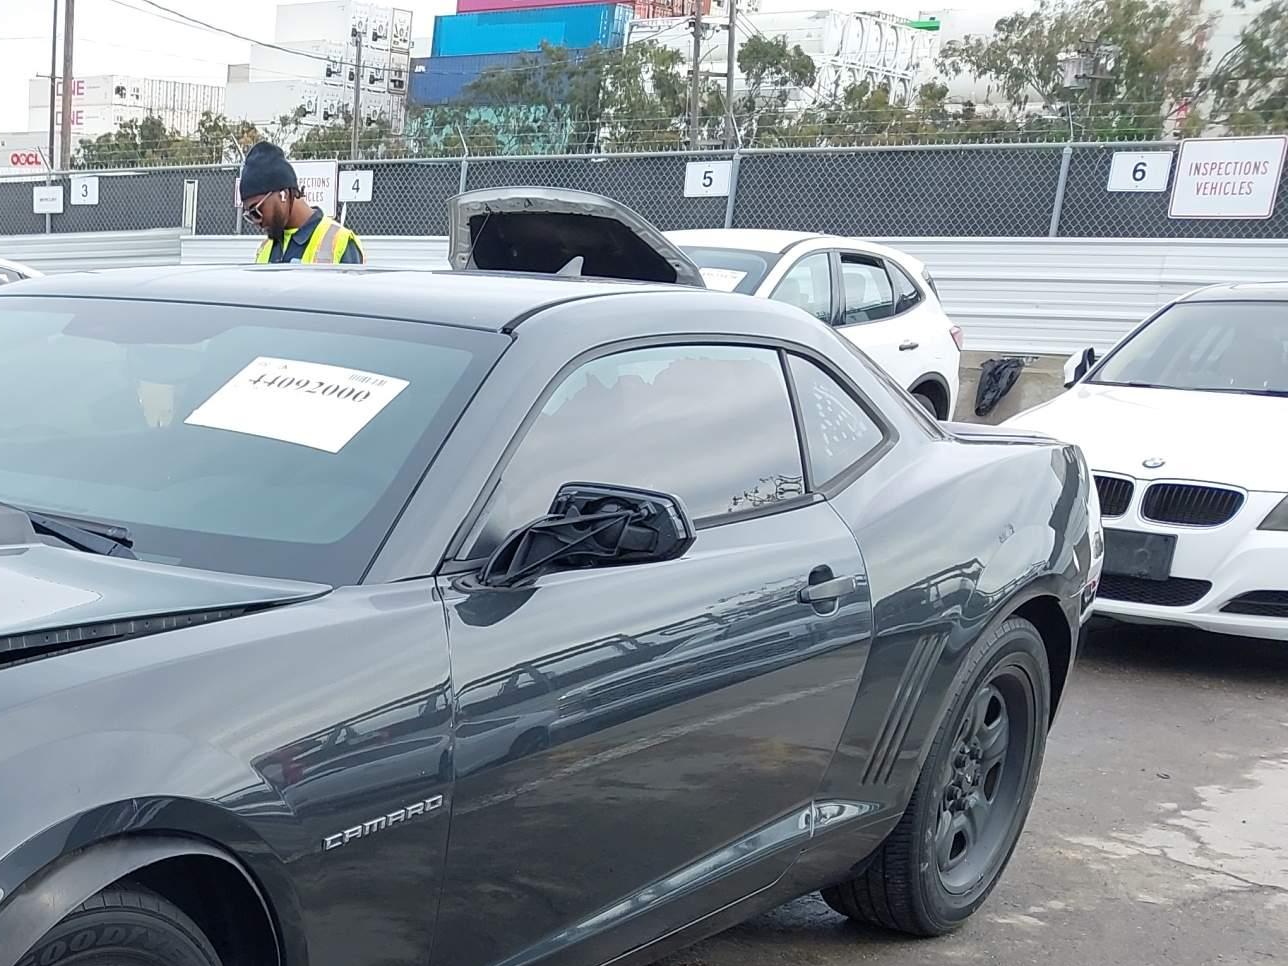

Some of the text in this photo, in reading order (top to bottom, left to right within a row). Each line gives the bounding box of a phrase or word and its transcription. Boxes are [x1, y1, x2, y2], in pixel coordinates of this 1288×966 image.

[1132, 162, 1147, 182] 6
[1189, 161, 1270, 177] INSPECTIONS
[298, 177, 330, 188] PECTIONS
[351, 178, 361, 194] 4
[702, 170, 714, 188] 5
[81, 184, 88, 198] 3
[1196, 181, 1254, 196] VEHICLES
[248, 373, 372, 403] 44092000
[322, 794, 444, 851] CAMARO
